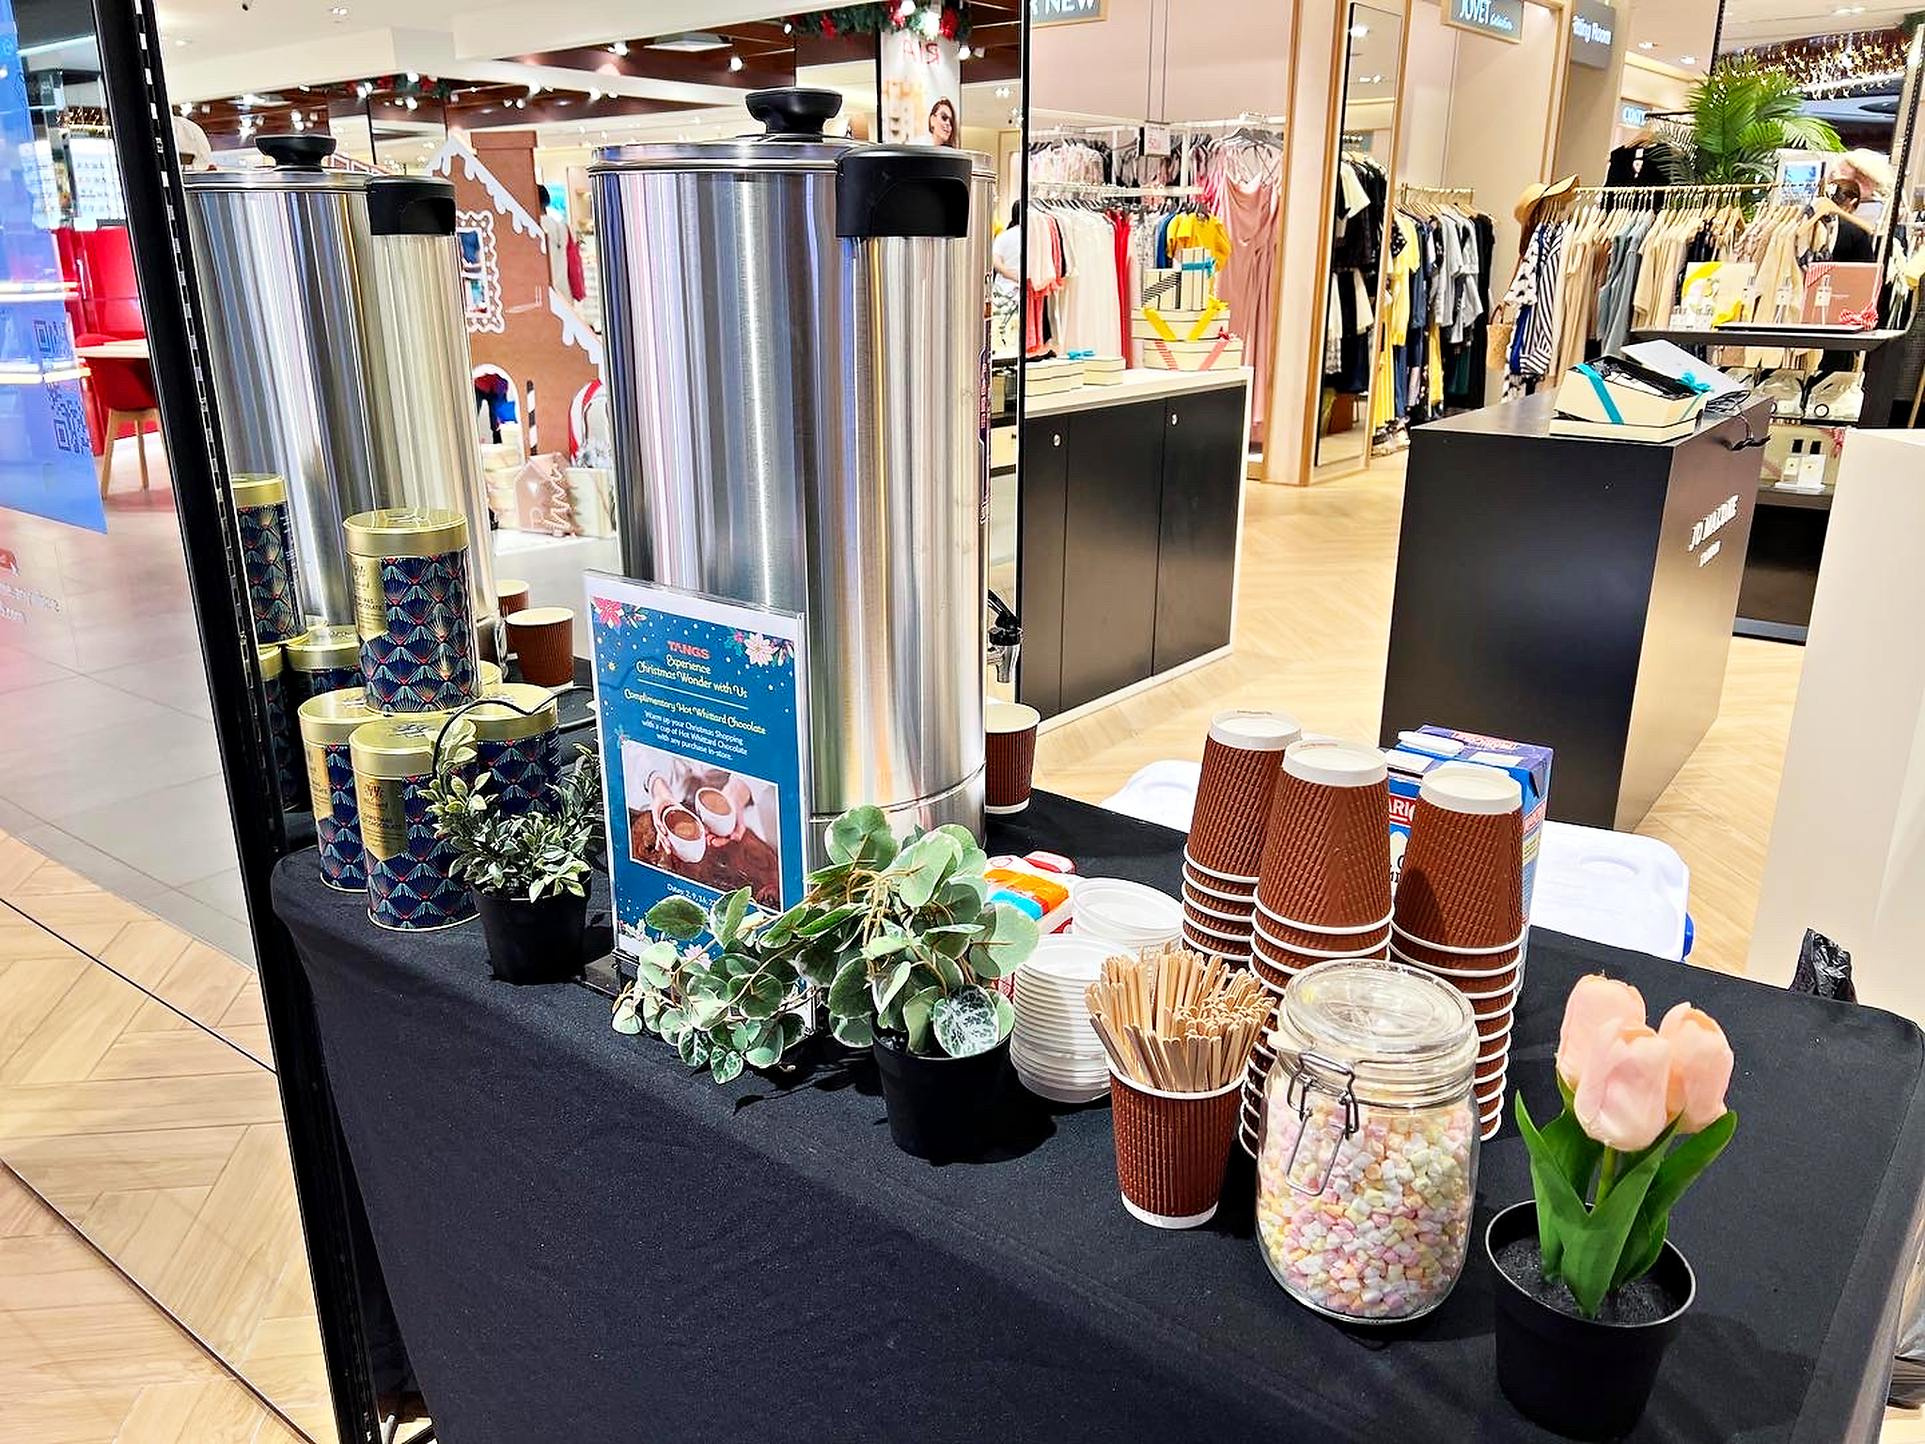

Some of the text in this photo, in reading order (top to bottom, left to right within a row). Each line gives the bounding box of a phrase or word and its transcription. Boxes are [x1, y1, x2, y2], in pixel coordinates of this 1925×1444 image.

[667, 641, 711, 660] TANGS
[666, 654, 712, 675] Experience
[636, 660, 748, 699] Christmas Wonder with Us
[662, 716, 671, 725] up
[671, 720, 685, 728] your
[685, 721, 715, 737] Christmas
[676, 702, 693, 715] Hot
[727, 716, 766, 735] Chocolate
[641, 719, 655, 729] with
[660, 725, 671, 734] cup
[678, 729, 690, 739] Hot
[717, 740, 748, 756] Chocolate
[656, 732, 670, 742] with
[670, 737, 681, 747] any
